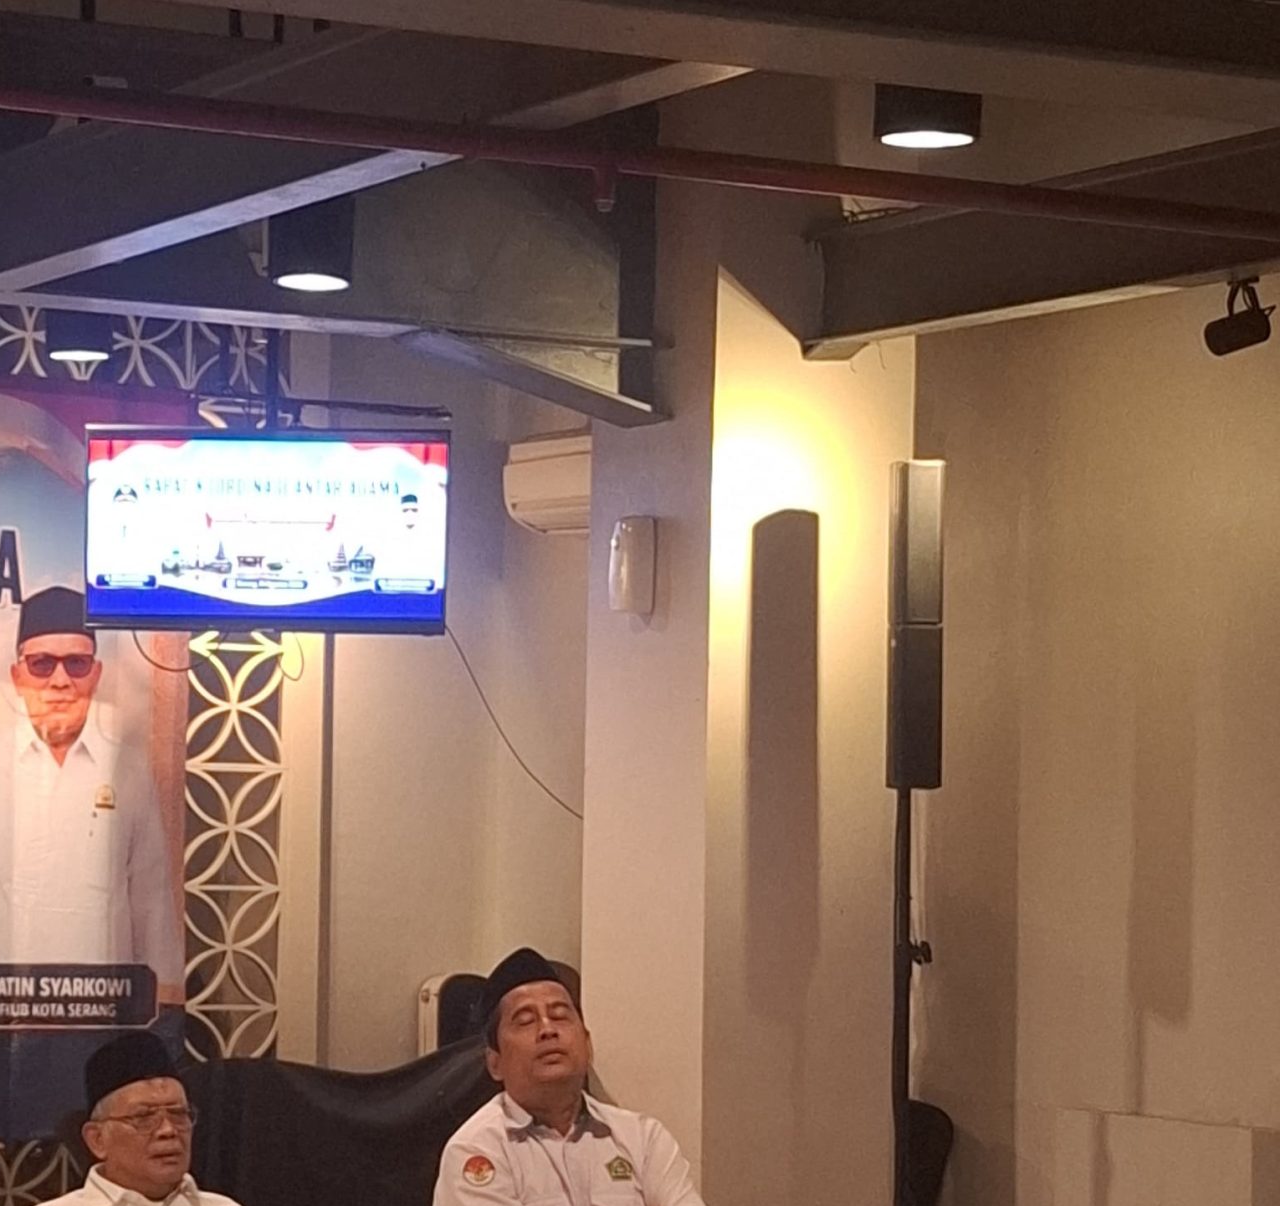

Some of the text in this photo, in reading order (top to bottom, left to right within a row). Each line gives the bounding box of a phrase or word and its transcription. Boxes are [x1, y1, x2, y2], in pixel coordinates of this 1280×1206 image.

[39, 977, 132, 998] SYARKOWI
[31, 1003, 64, 1018] KOTA
[67, 1003, 118, 1018] SERANG
